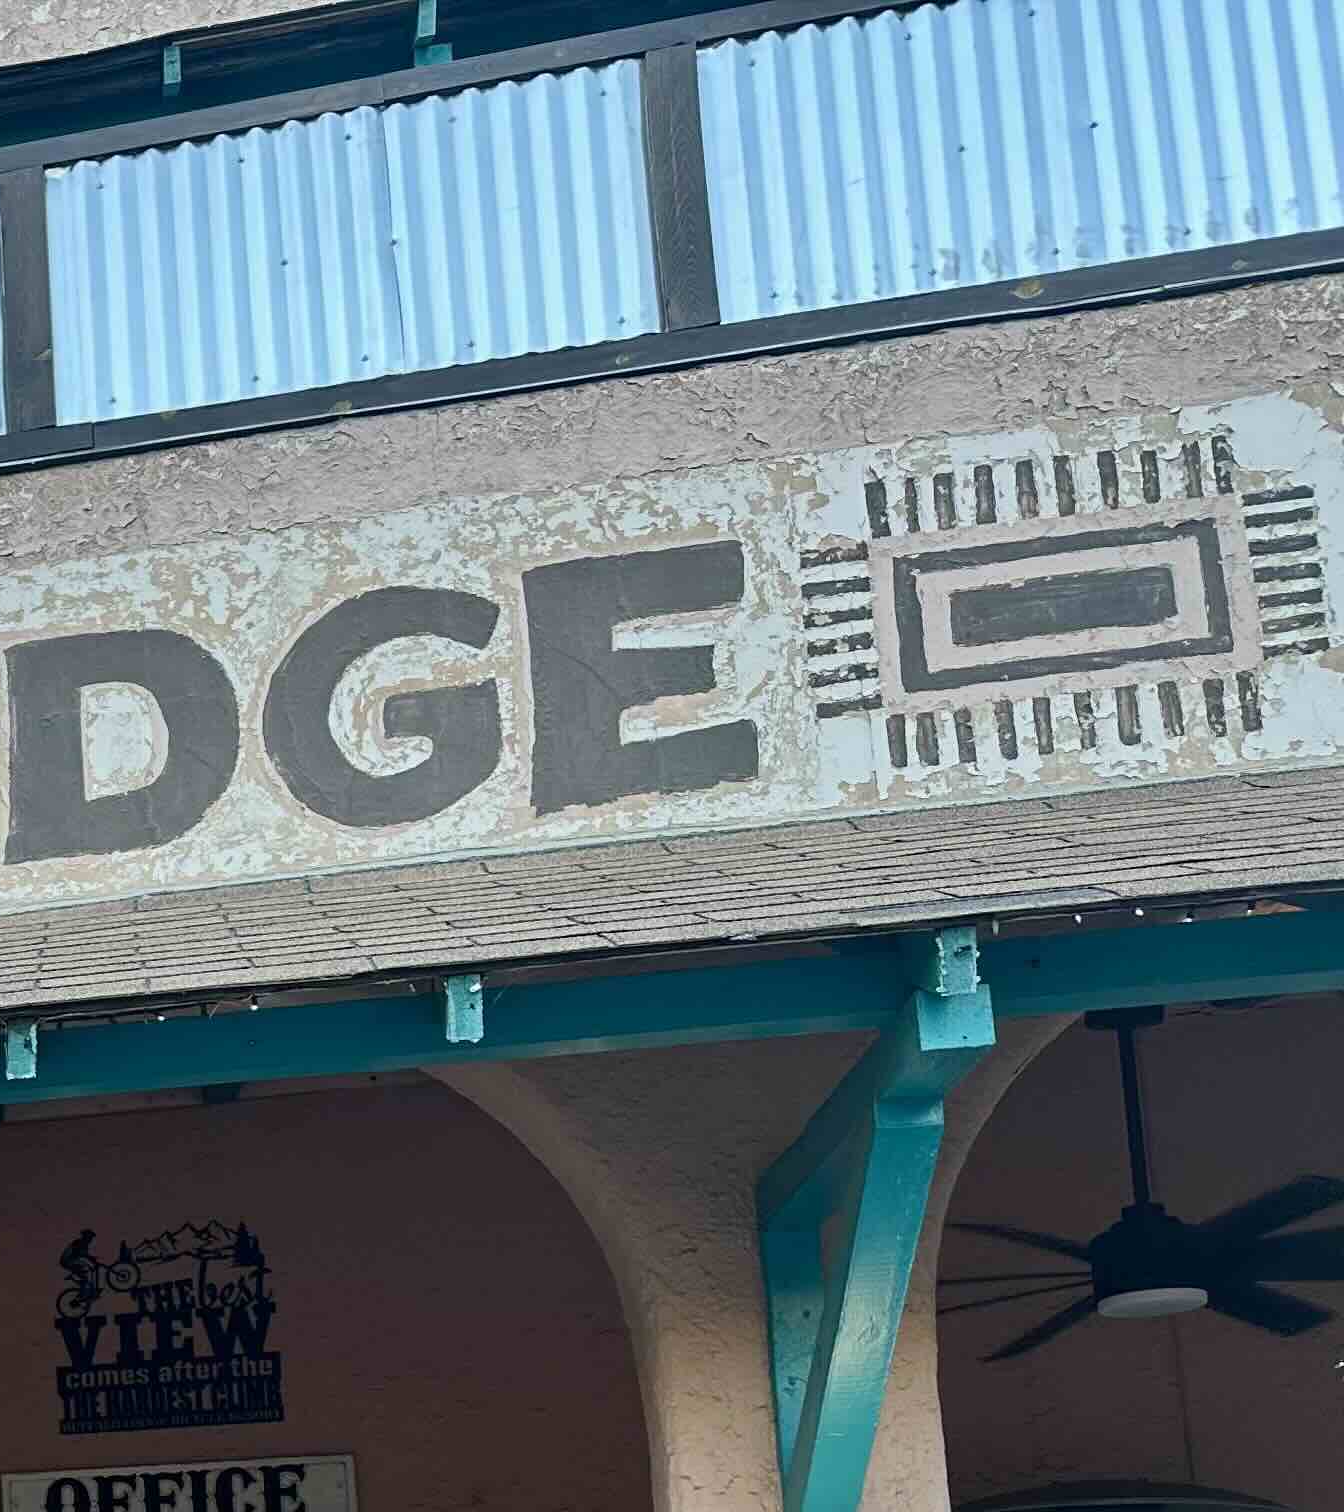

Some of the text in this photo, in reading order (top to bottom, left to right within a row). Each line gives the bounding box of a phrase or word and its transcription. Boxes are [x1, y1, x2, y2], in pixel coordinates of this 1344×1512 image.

[130, 1279, 194, 1313] THE
[54, 1301, 277, 1368] VIEW
[65, 1355, 273, 1390] comes after the
